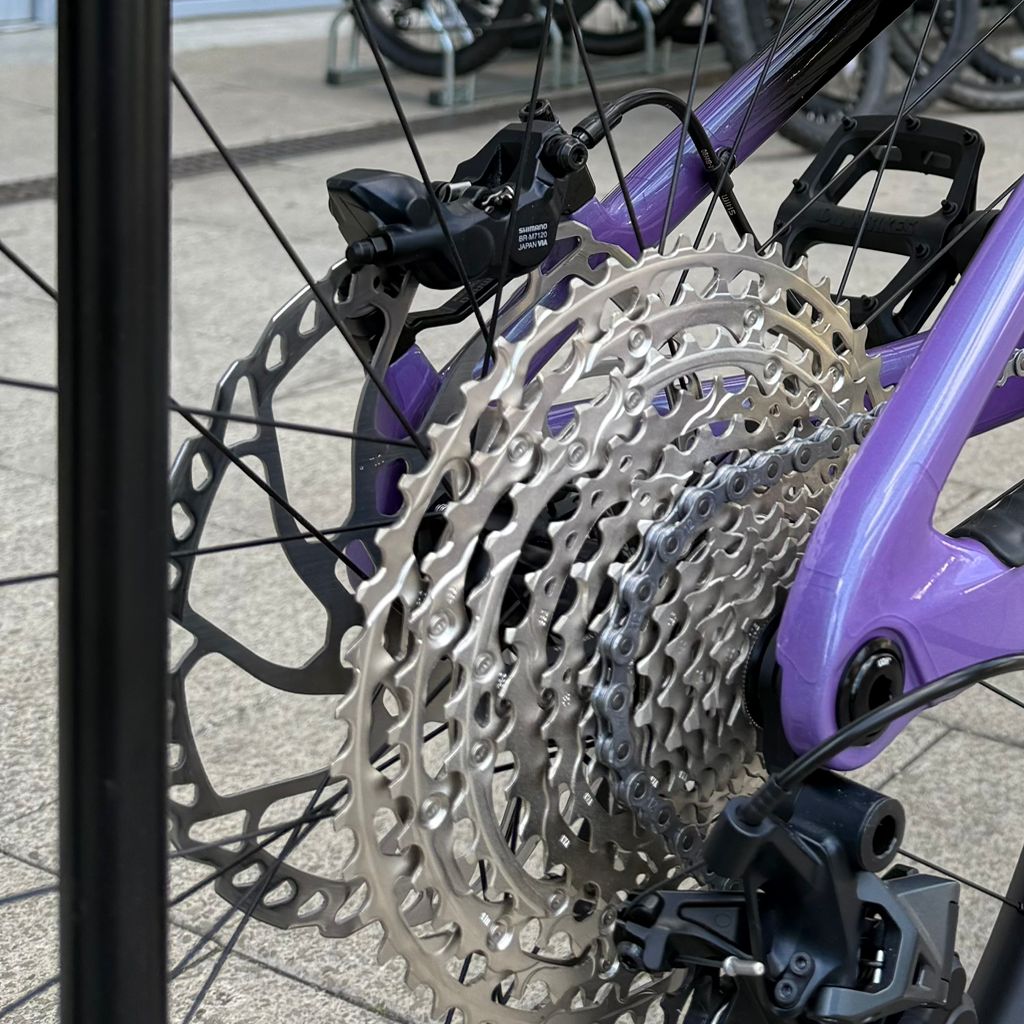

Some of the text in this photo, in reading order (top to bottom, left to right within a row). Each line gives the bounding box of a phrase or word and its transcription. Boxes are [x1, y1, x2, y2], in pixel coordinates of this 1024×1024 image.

[519, 223, 548, 234] SHIMANO
[519, 231, 548, 243] BR-M7120
[518, 241, 537, 251] JAPAN
